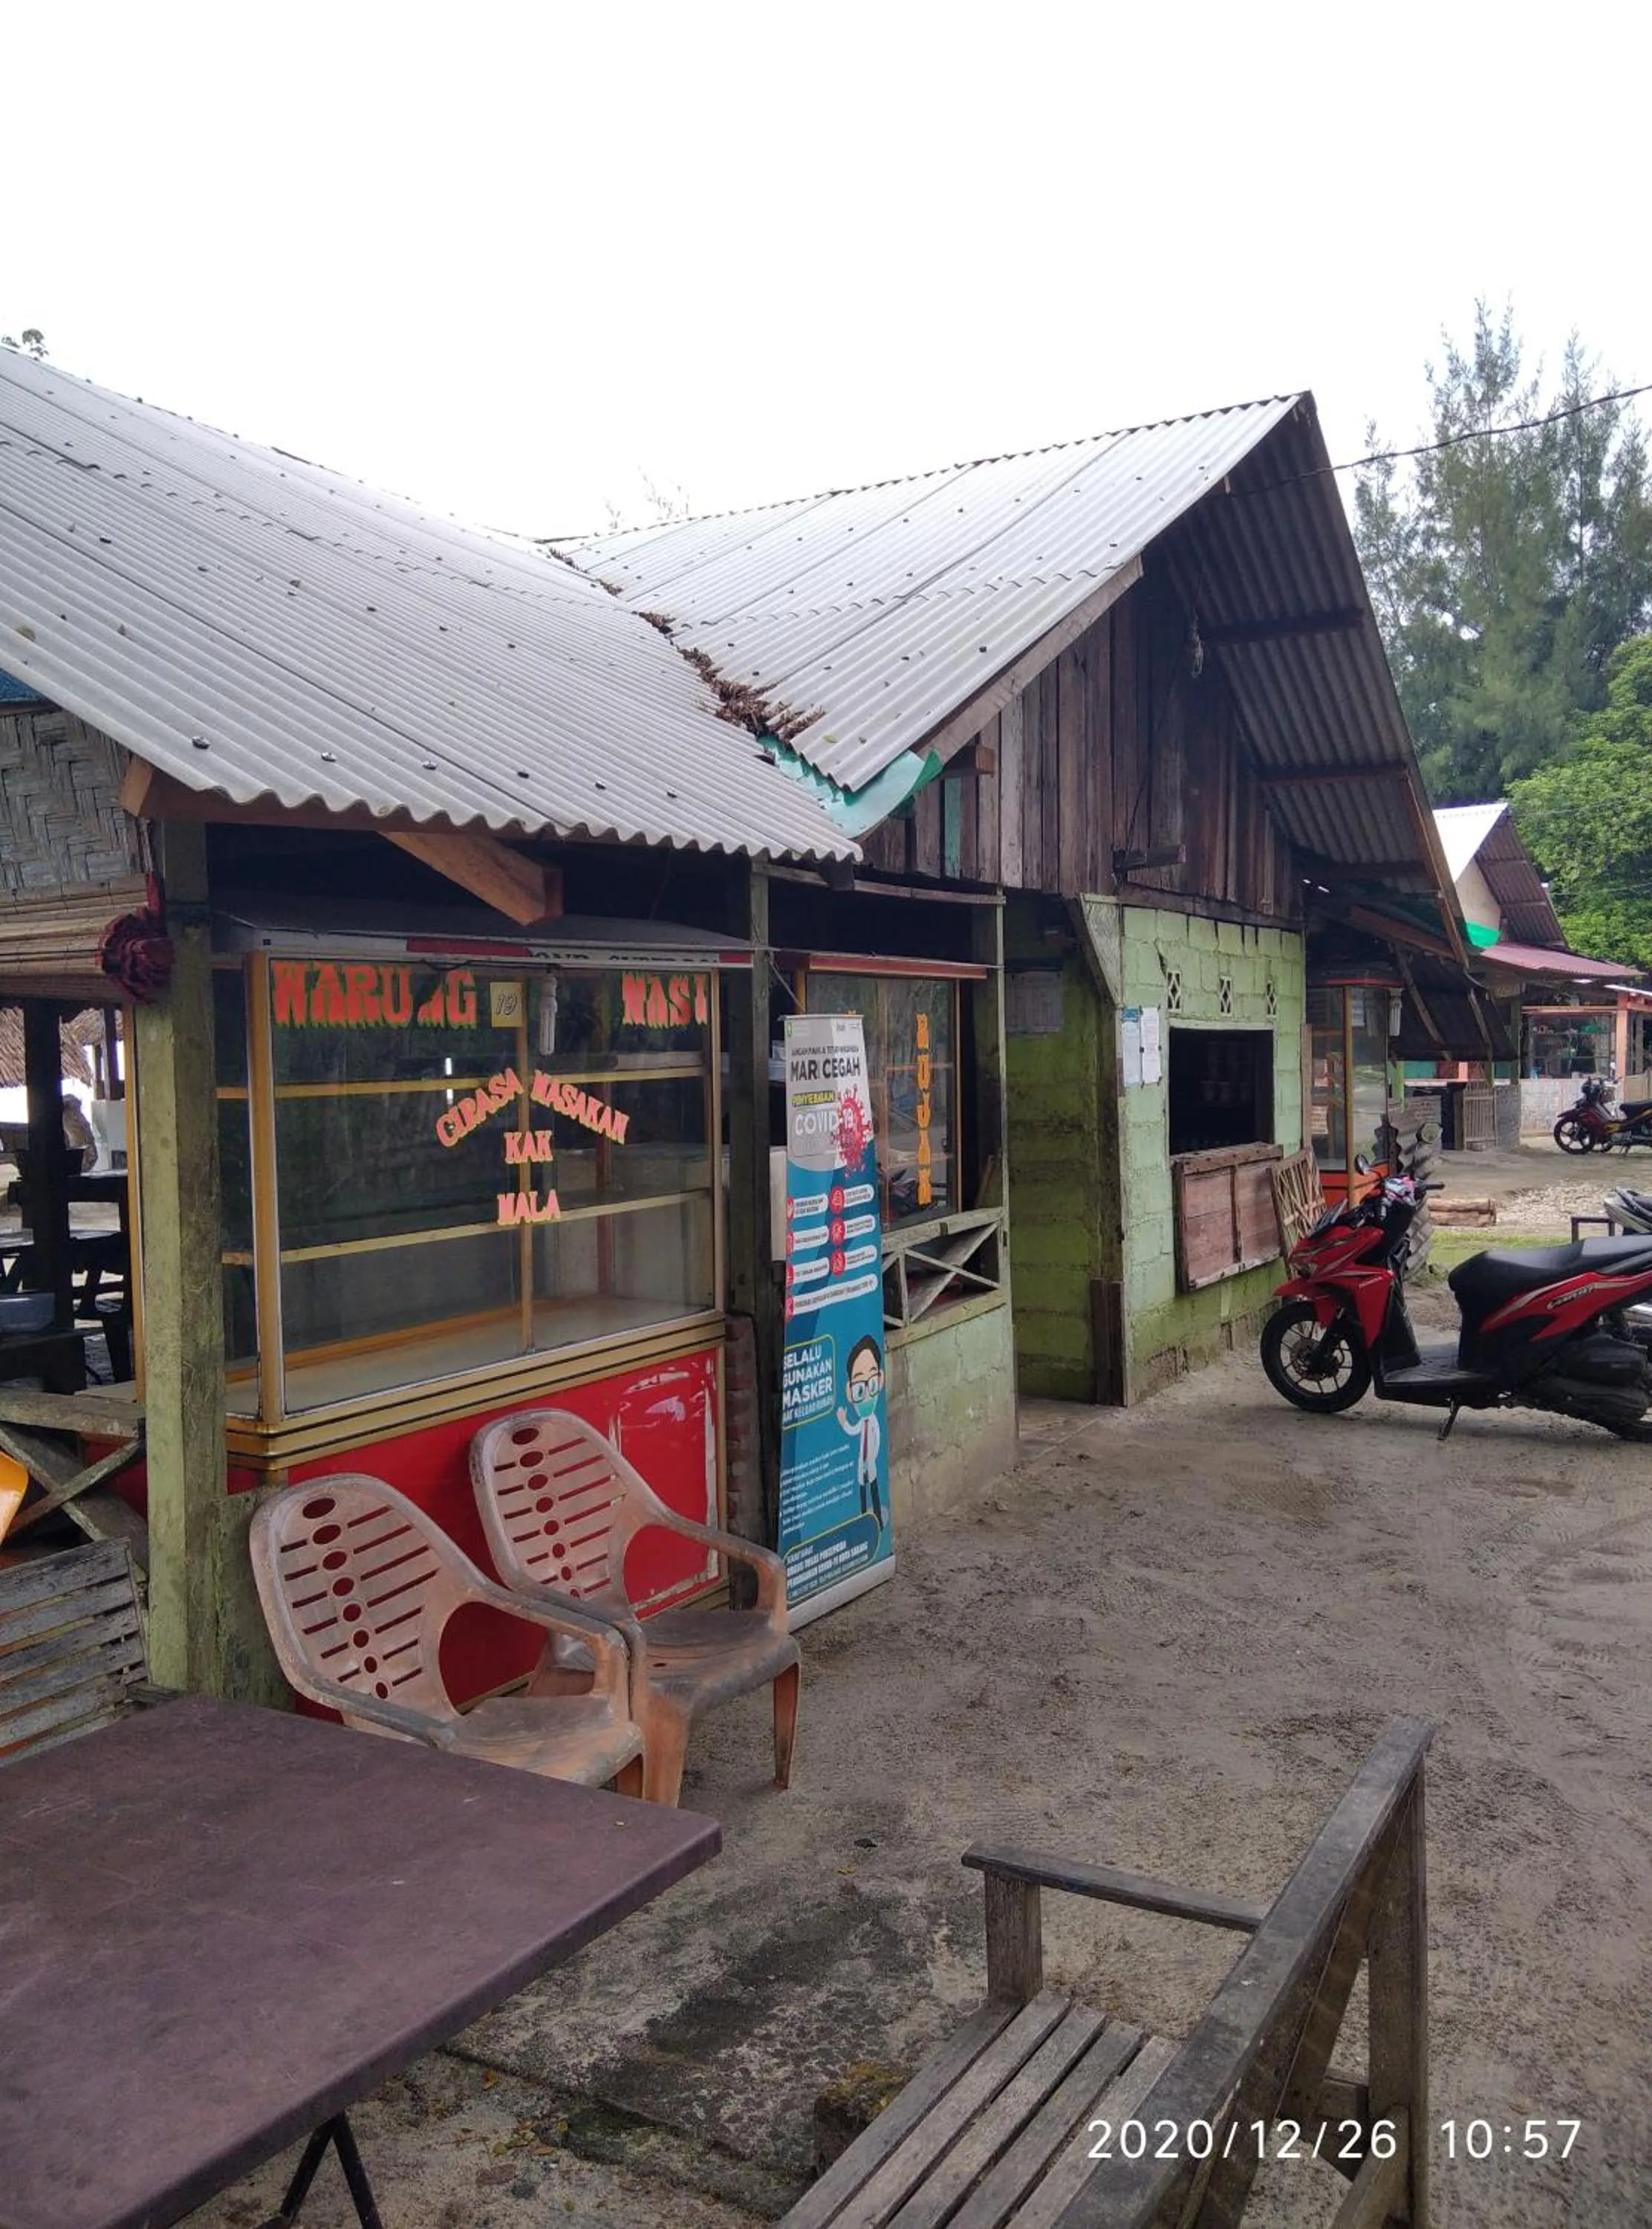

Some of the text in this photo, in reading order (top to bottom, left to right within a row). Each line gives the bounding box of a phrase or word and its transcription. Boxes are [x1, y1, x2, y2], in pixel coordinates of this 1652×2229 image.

[621, 970, 708, 1029] NASI
[790, 1056, 860, 1082] MARI CEGAH
[530, 1069, 629, 1145] MASAKAN
[504, 1130, 553, 1164] KAK
[783, 1357, 832, 1388] GUNAKAN
[783, 1375, 833, 1409] MASKER
